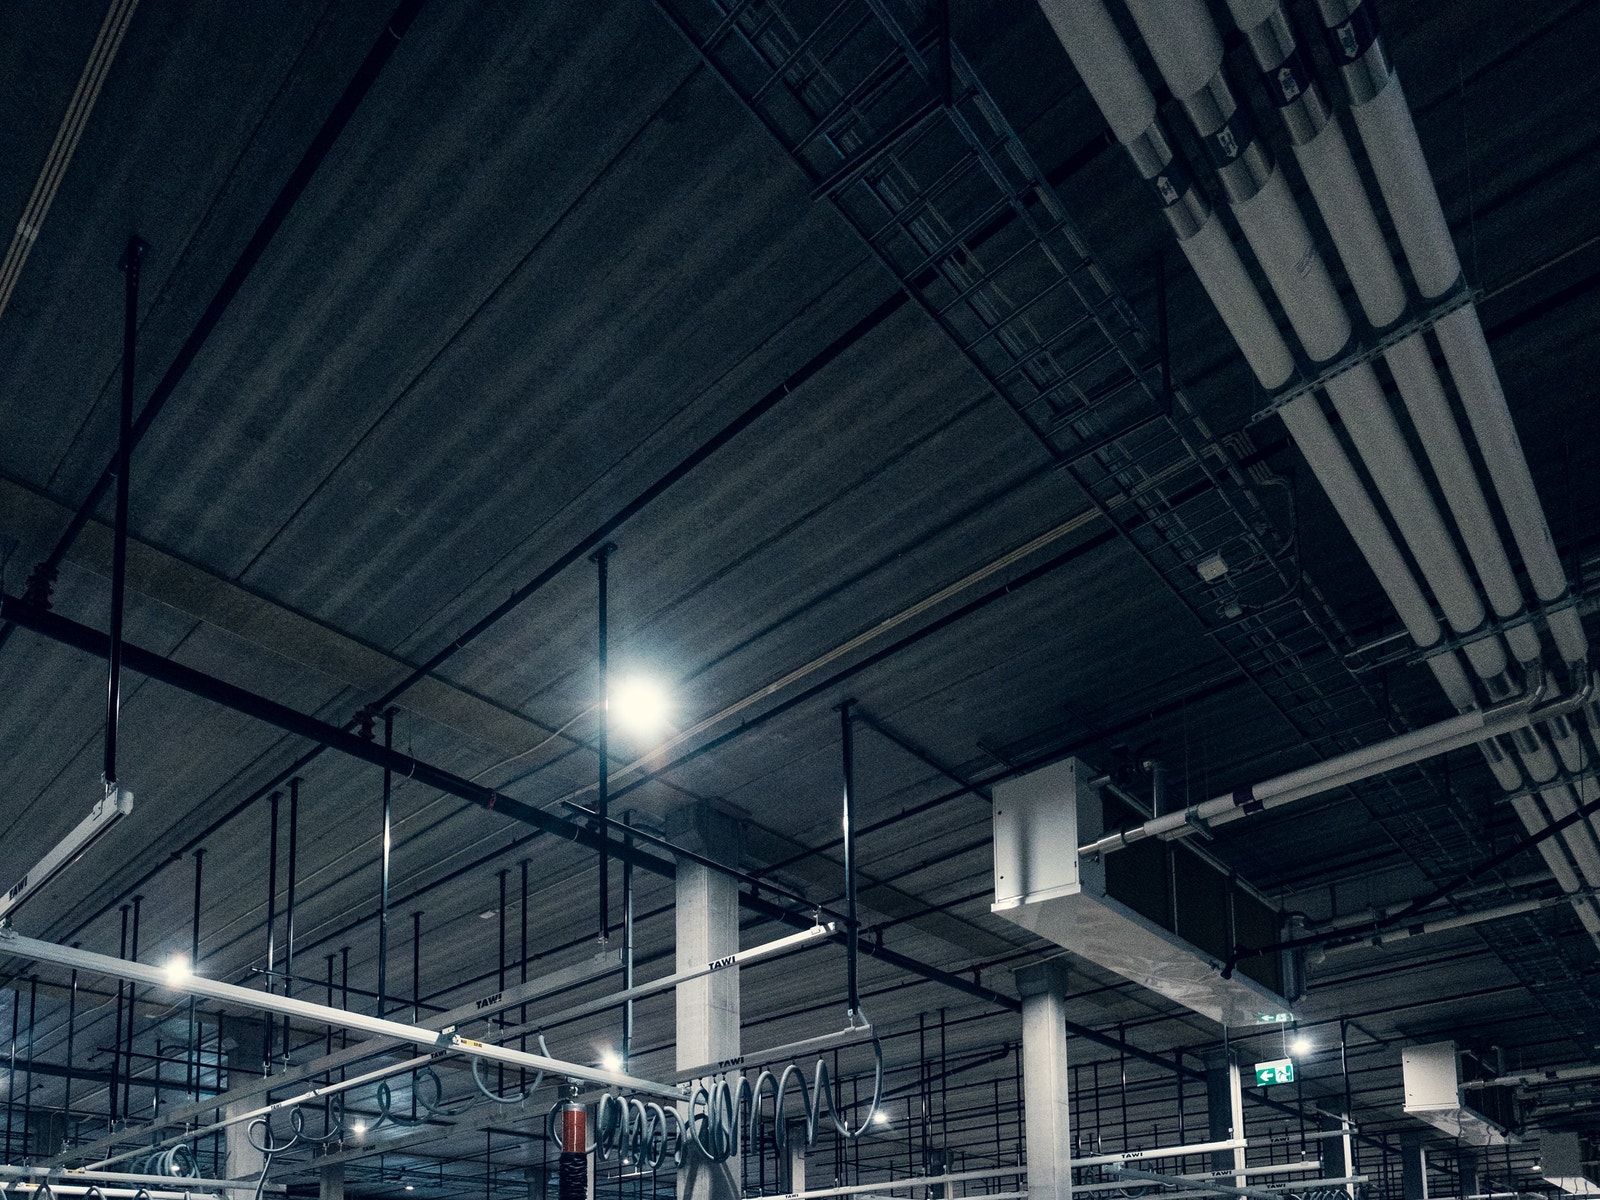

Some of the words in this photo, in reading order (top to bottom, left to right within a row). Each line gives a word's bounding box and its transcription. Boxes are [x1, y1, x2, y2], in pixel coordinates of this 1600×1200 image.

[9, 875, 28, 901] TAWI
[708, 955, 736, 970] TAWI
[476, 993, 502, 1010] TAWI
[430, 1050, 447, 1059] TAWI
[718, 1056, 745, 1069] TAWI
